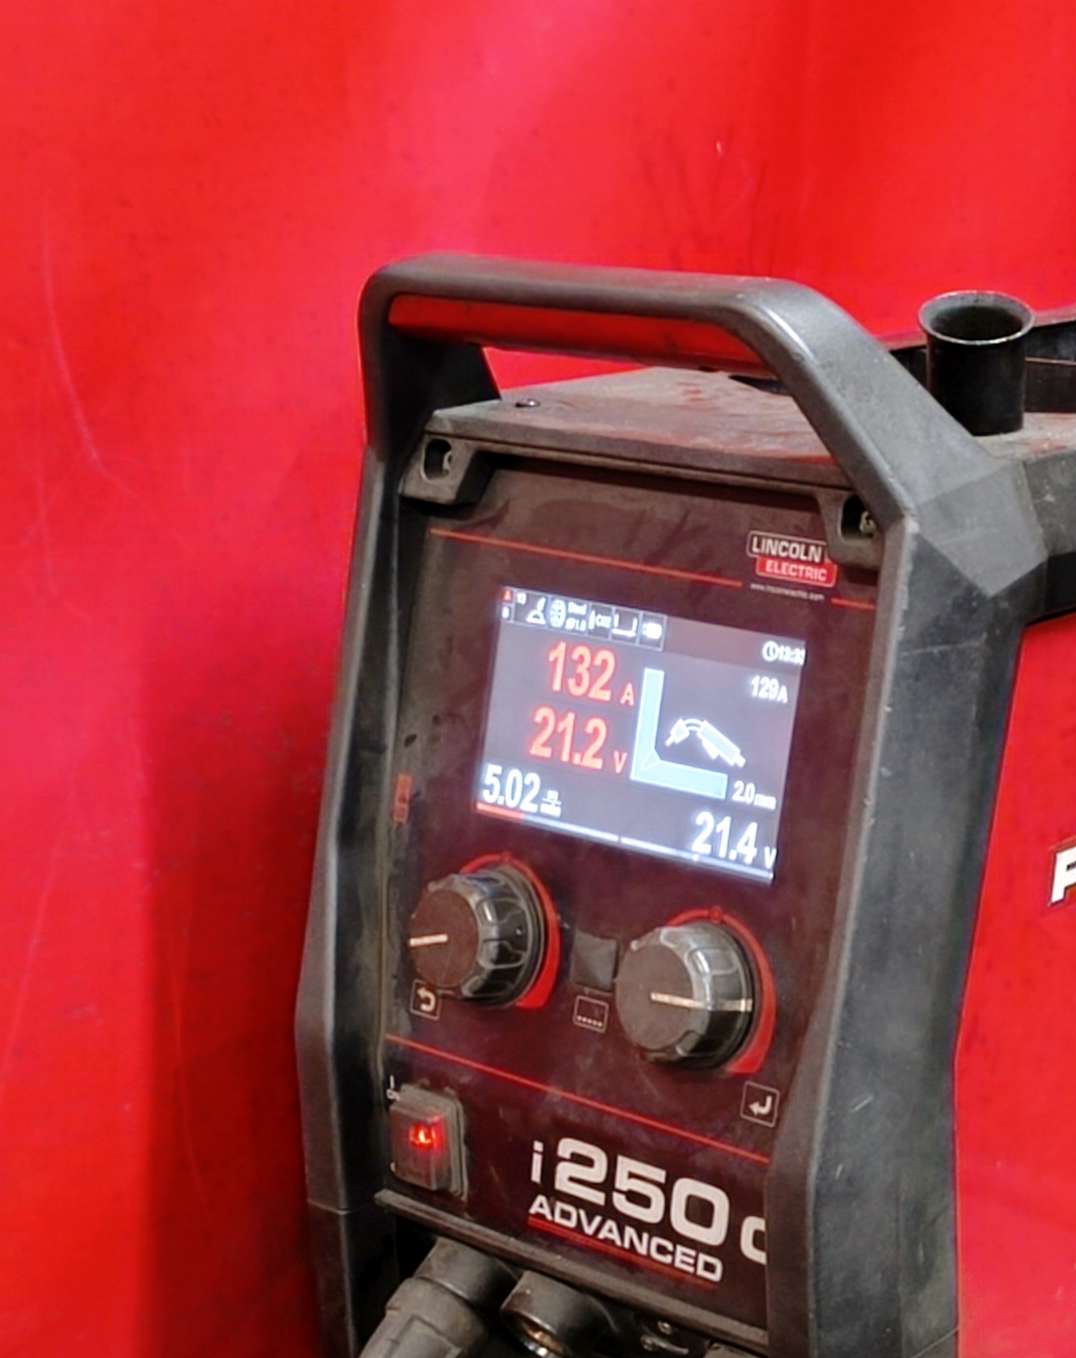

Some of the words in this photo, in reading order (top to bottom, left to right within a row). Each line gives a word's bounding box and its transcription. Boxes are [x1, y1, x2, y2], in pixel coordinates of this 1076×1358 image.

[752, 536, 822, 563] LINCOLN
[765, 559, 828, 582] ELECTRIC
[548, 641, 616, 702] 132
[619, 682, 635, 707] A
[529, 705, 608, 770] 21.2
[482, 763, 541, 814] 5.02
[691, 811, 758, 865] 21.4
[528, 1194, 724, 1283] ADVANCED
